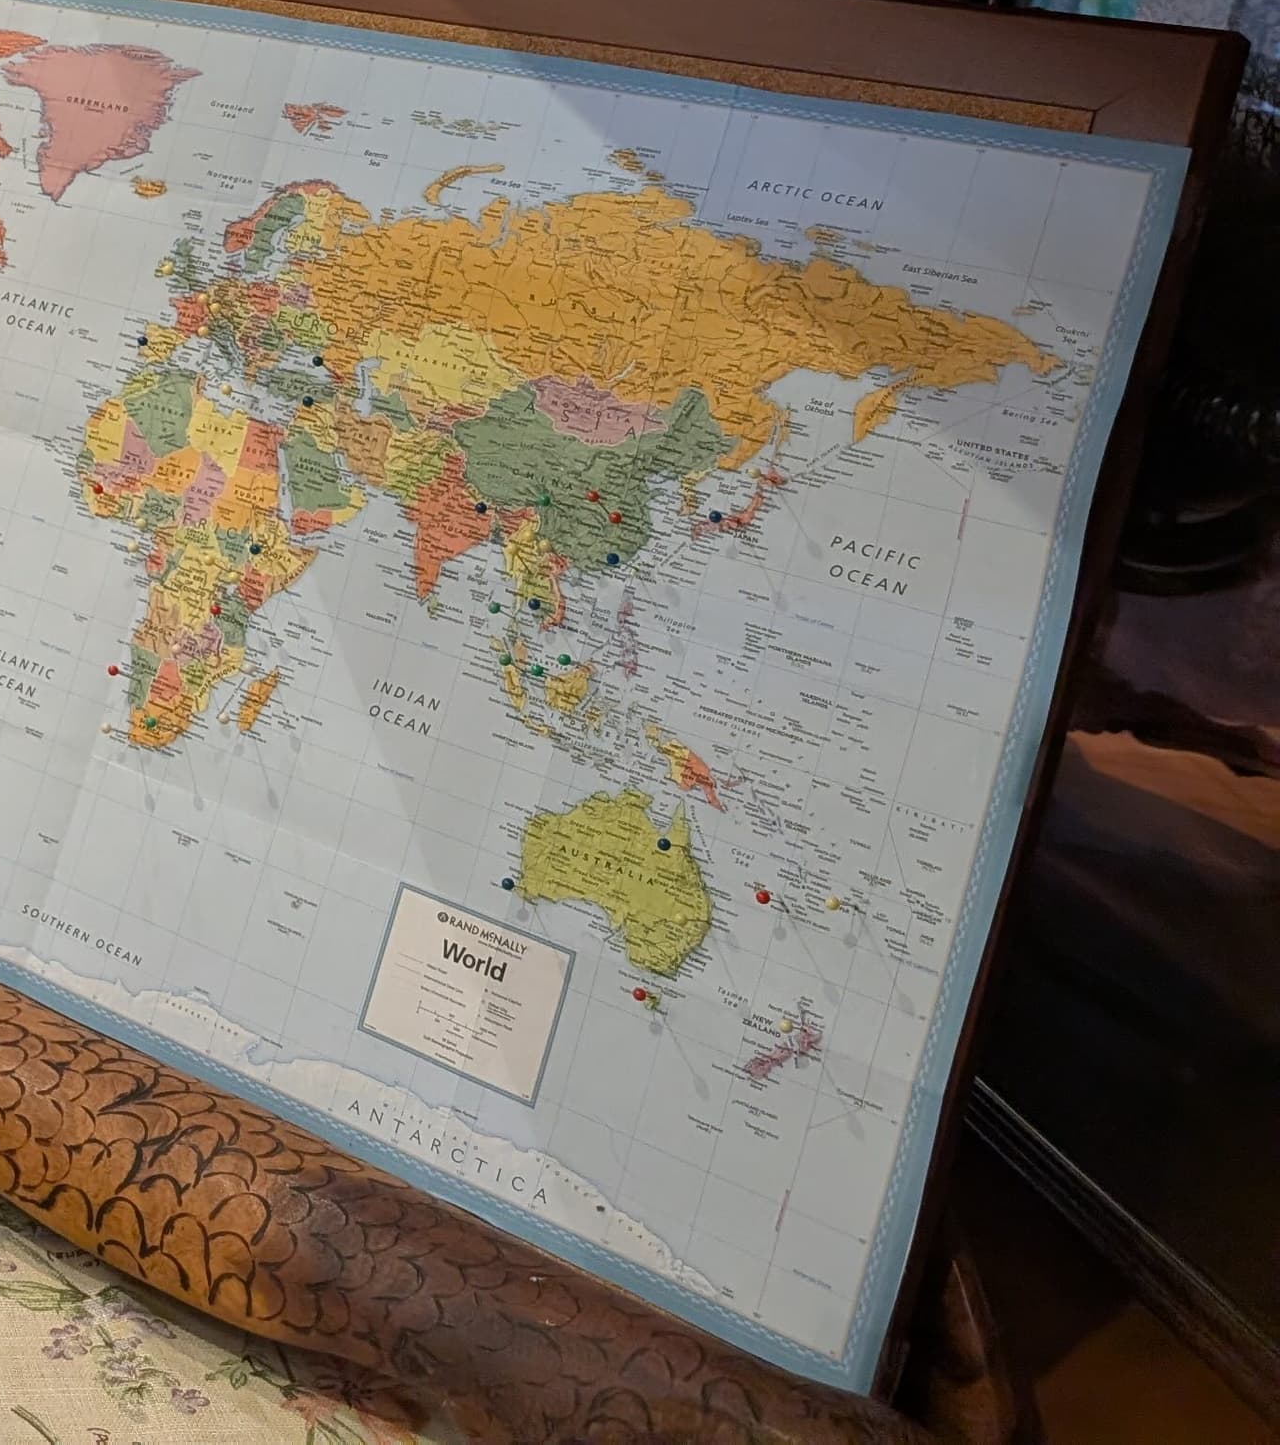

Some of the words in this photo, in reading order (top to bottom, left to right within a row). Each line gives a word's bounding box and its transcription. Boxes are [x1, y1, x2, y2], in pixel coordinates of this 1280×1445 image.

[66, 95, 130, 114] GREENLAND
[210, 100, 255, 115] Greenland
[221, 111, 237, 120] Sea
[207, 170, 253, 186] Norwegian
[220, 181, 235, 190] Sea
[747, 179, 814, 201] ARCTIC
[820, 191, 886, 213] OCEAN
[902, 263, 922, 275] East
[924, 267, 959, 283] Siberian
[961, 274, 979, 285] Sea
[1, 290, 75, 319] ATLANTIC
[6, 314, 57, 337] OCEAN
[277, 310, 371, 347] EUROPE
[956, 438, 992, 455] UNITED
[994, 448, 1029, 462] STATES
[733, 532, 760, 545] JAPAN
[829, 535, 922, 570] PACIFIC
[829, 563, 909, 596] OCEAN
[372, 678, 442, 713] INDIAN
[368, 704, 433, 737] OCEAN
[559, 844, 656, 887] AUSTRALIA
[20, 903, 91, 945] SOUTHERN
[93, 938, 144, 967] OCEAN
[448, 915, 481, 936] RAND
[480, 928, 529, 956] McNALLY
[442, 938, 509, 983] World
[742, 1018, 782, 1039] ZEALAND
[751, 1013, 775, 1026] NEW
[347, 1098, 550, 1206] ANTARCTICA
